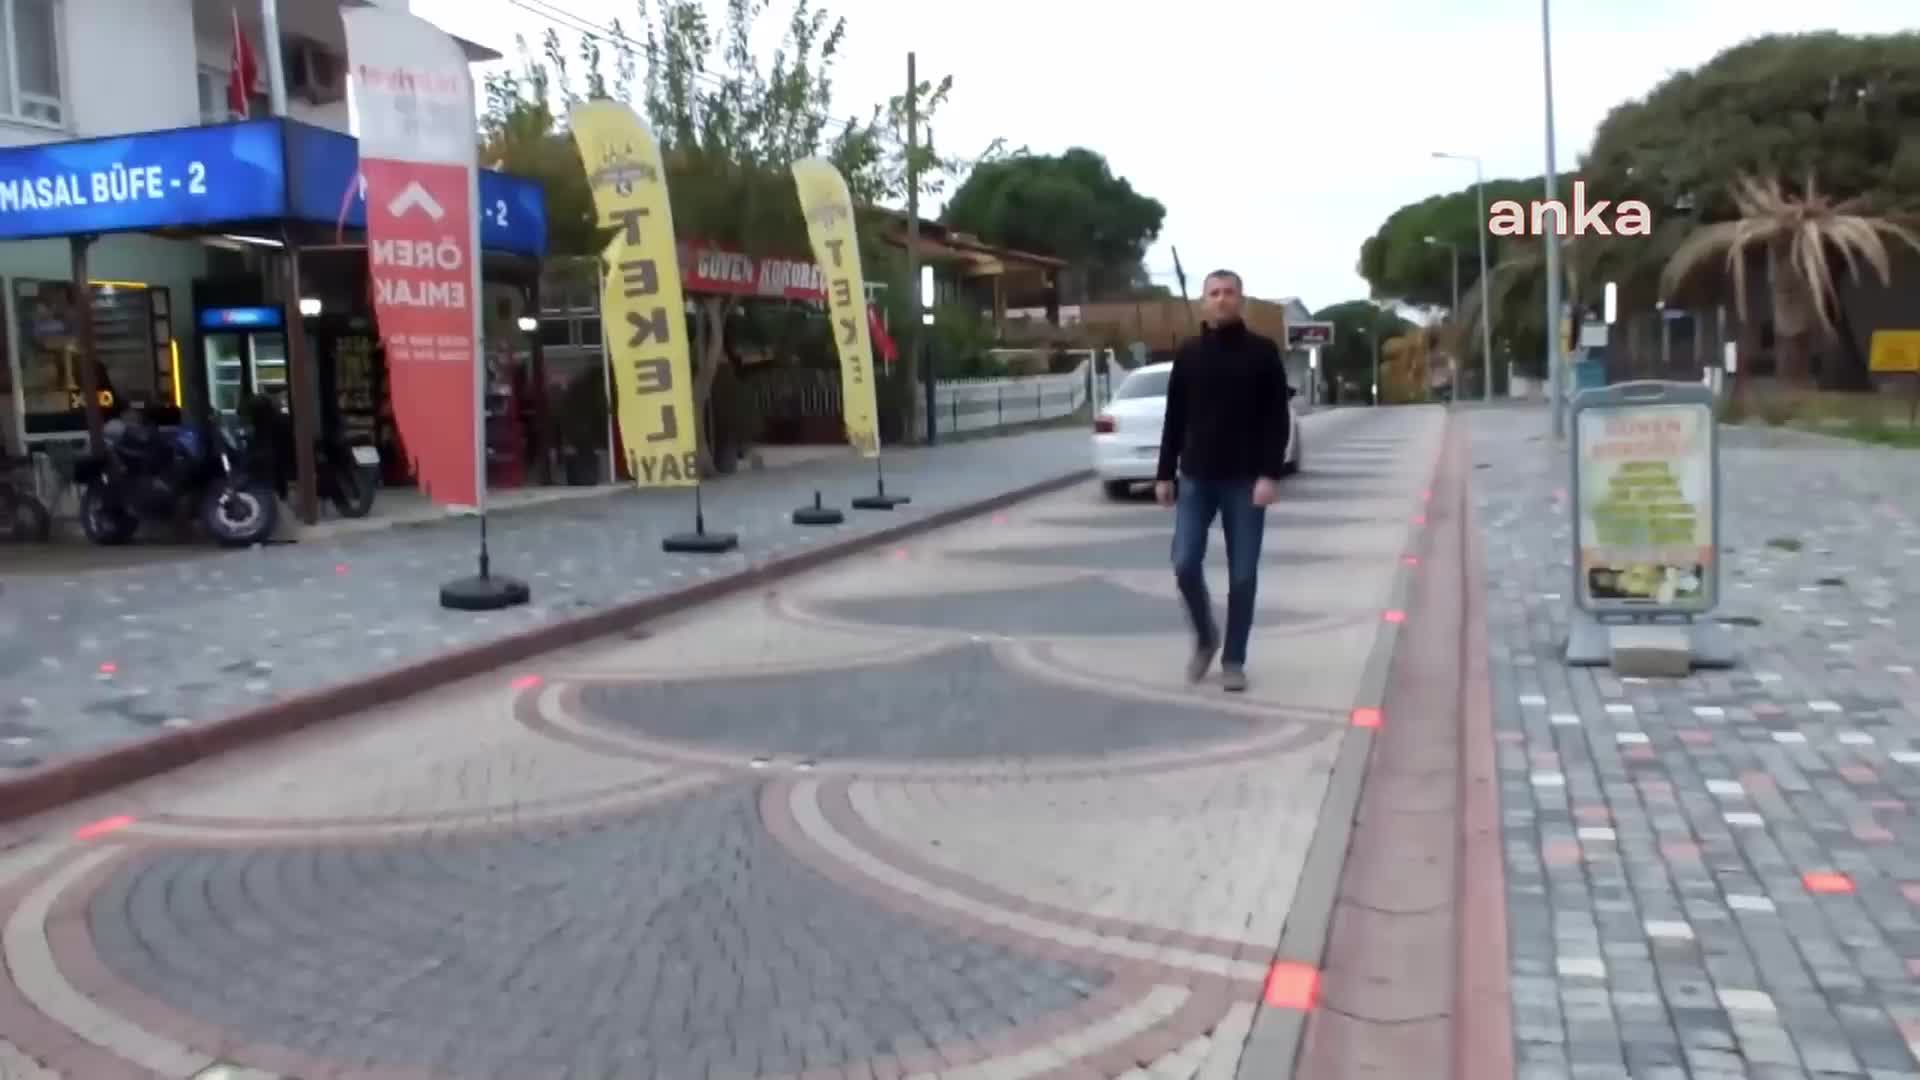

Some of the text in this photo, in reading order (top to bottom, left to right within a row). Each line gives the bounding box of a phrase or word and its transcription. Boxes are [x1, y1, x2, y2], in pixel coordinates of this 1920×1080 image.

[0, 173, 87, 212] MASAL
[91, 162, 164, 204] BÜFE
[188, 160, 207, 195] 2
[496, 199, 509, 227] 2
